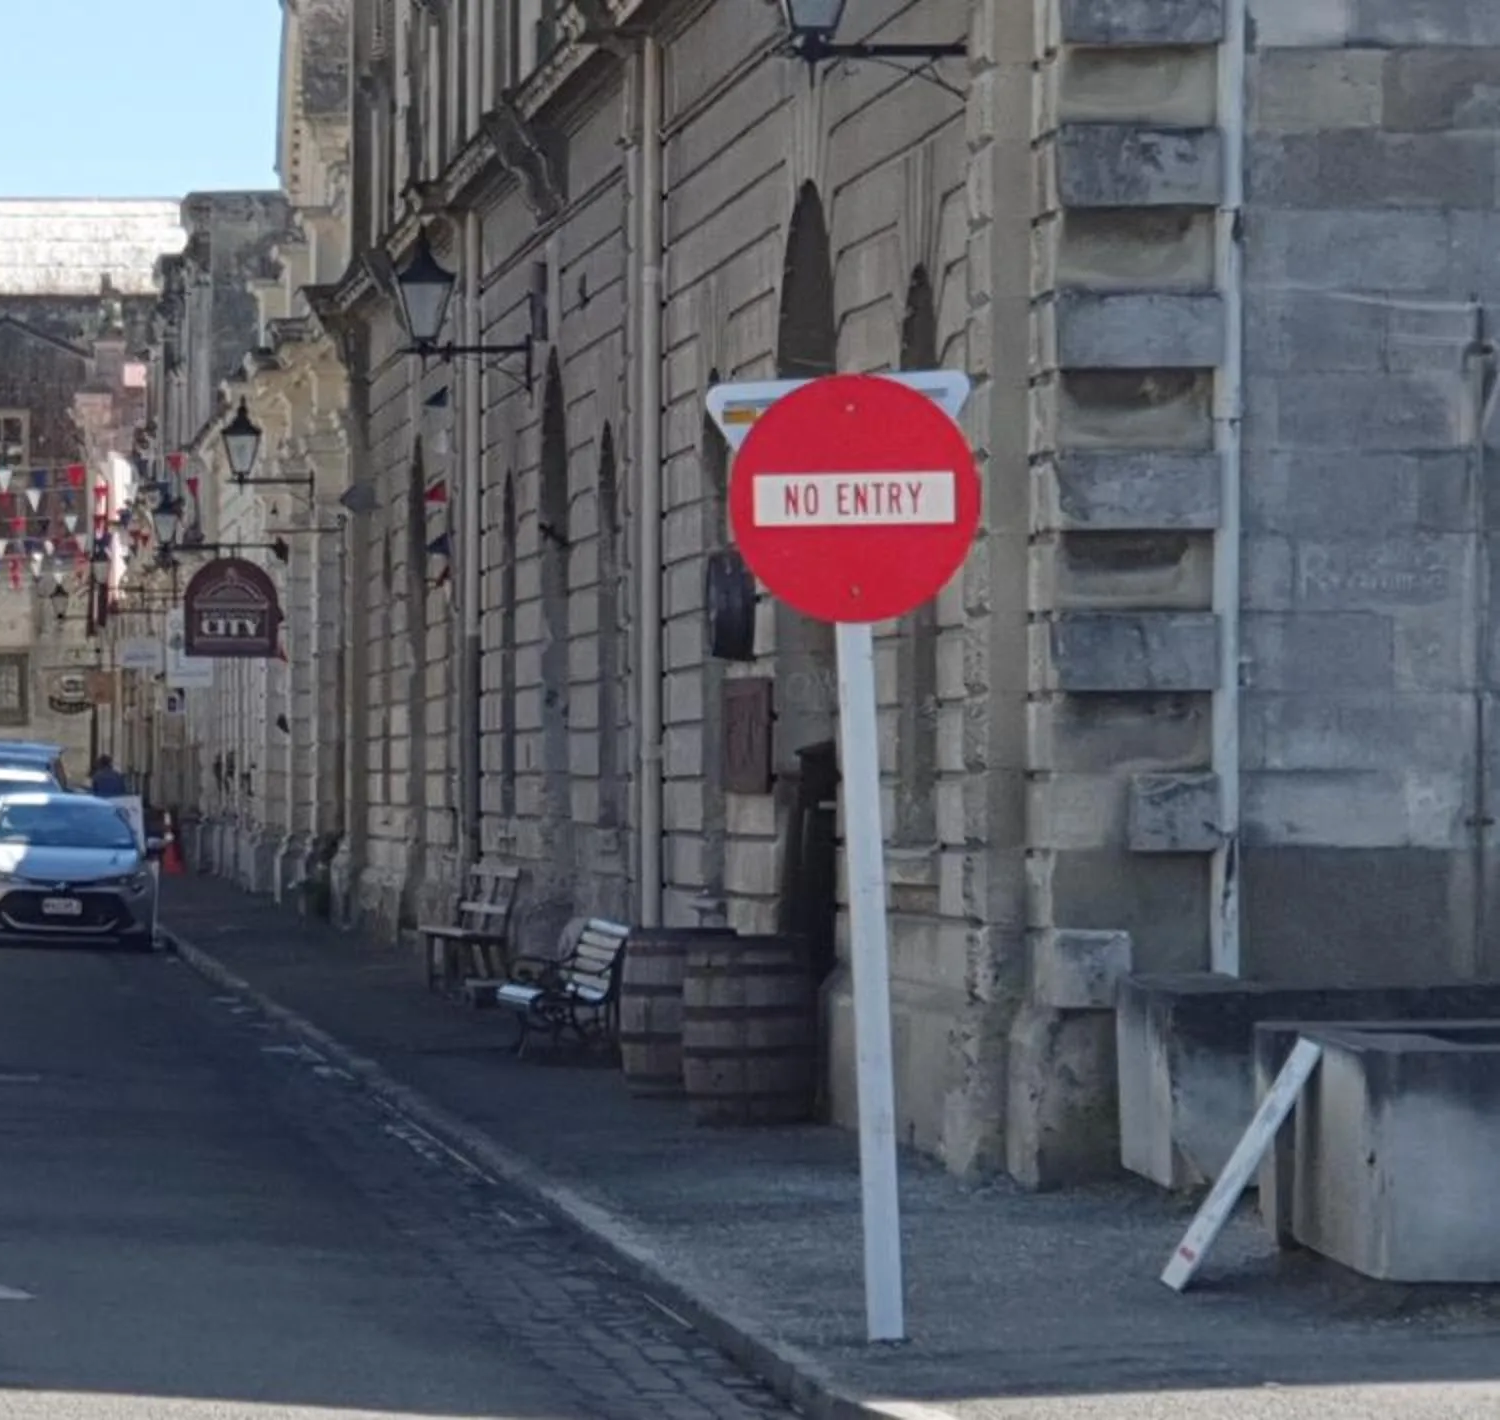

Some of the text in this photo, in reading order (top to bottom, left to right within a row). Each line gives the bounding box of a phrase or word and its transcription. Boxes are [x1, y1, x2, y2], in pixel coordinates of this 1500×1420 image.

[784, 481, 922, 516] NO ENTRY
[201, 618, 261, 636] CITY
